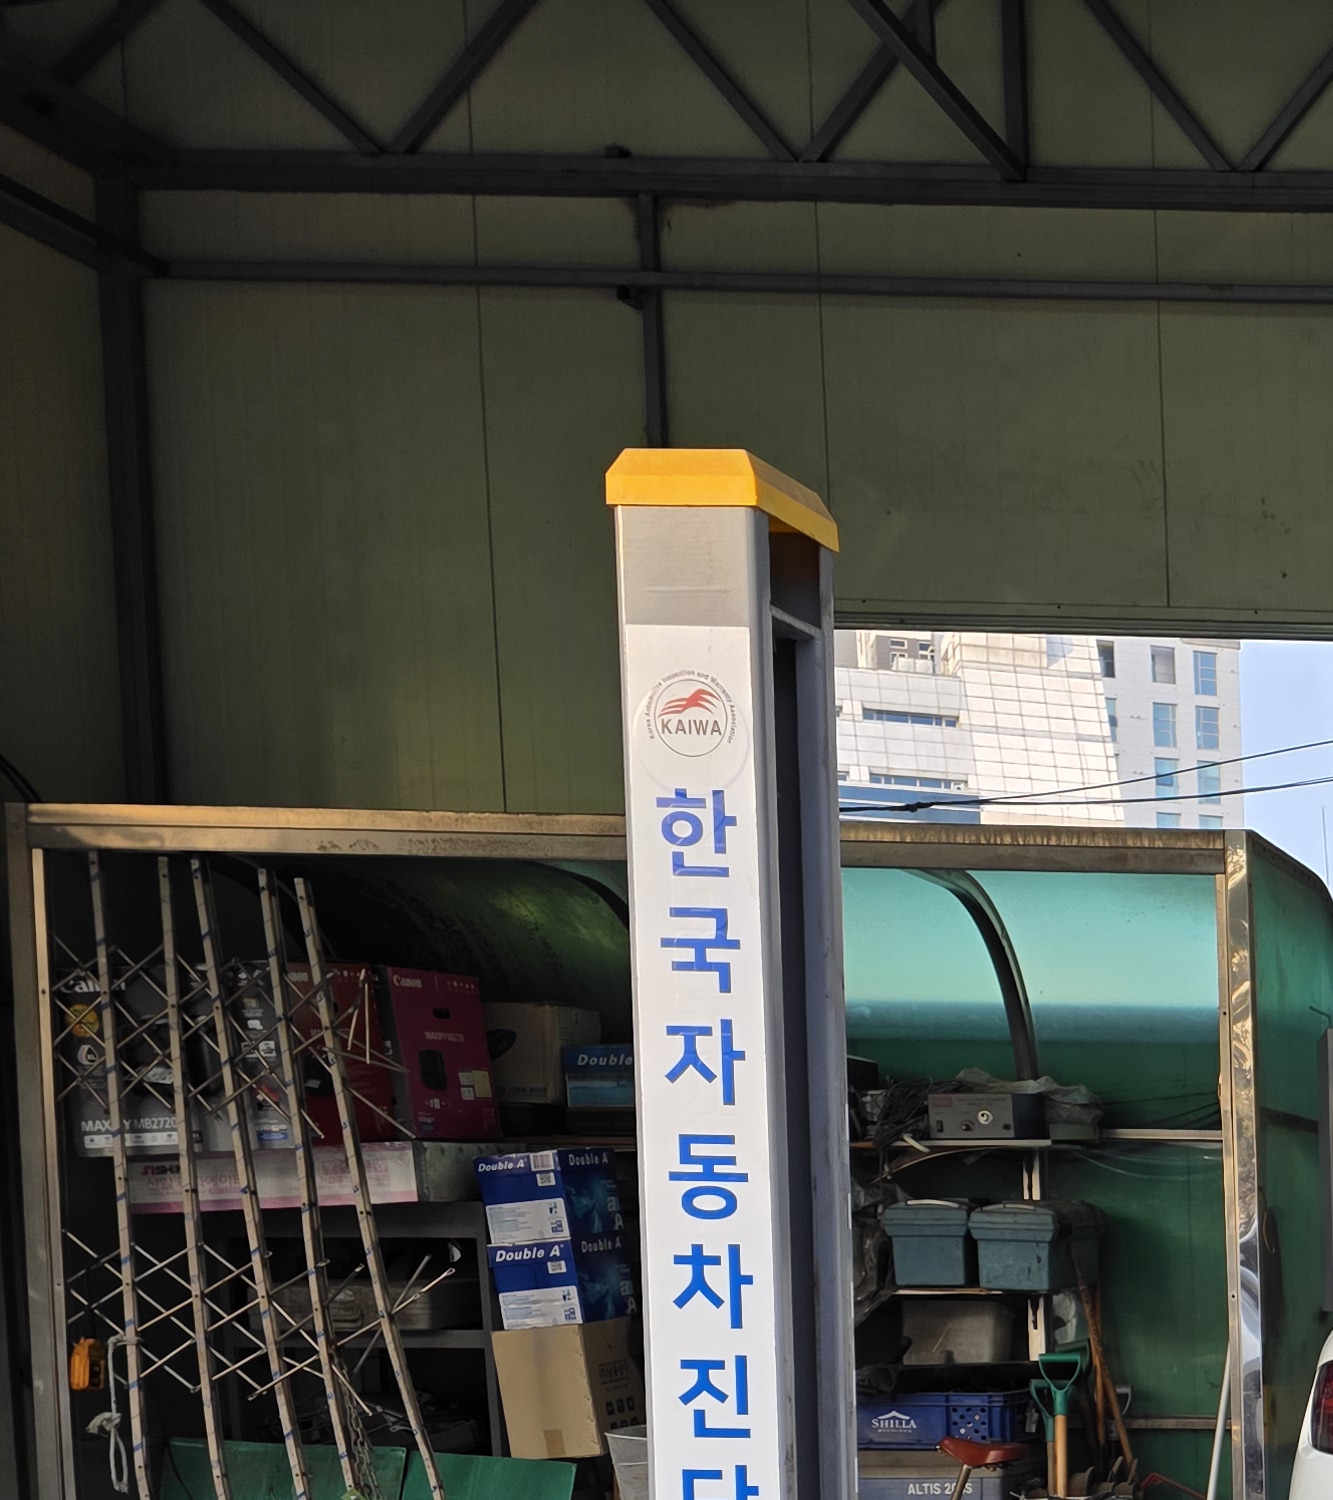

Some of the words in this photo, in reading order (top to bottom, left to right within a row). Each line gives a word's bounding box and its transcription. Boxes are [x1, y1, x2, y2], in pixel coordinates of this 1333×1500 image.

[661, 718, 722, 736] KAIWA
[393, 974, 422, 989] Canon
[577, 1054, 632, 1066] Double
[478, 1161, 513, 1172] Double
[516, 1159, 525, 1169] A
[568, 1153, 599, 1166] Double
[602, 1152, 609, 1164] A
[581, 1240, 612, 1253] Double
[615, 1237, 622, 1249] A
[495, 1247, 545, 1262] Double
[550, 1244, 561, 1258] A
[871, 1418, 917, 1429] SHILLA
[907, 1484, 941, 1495] ALTIS
